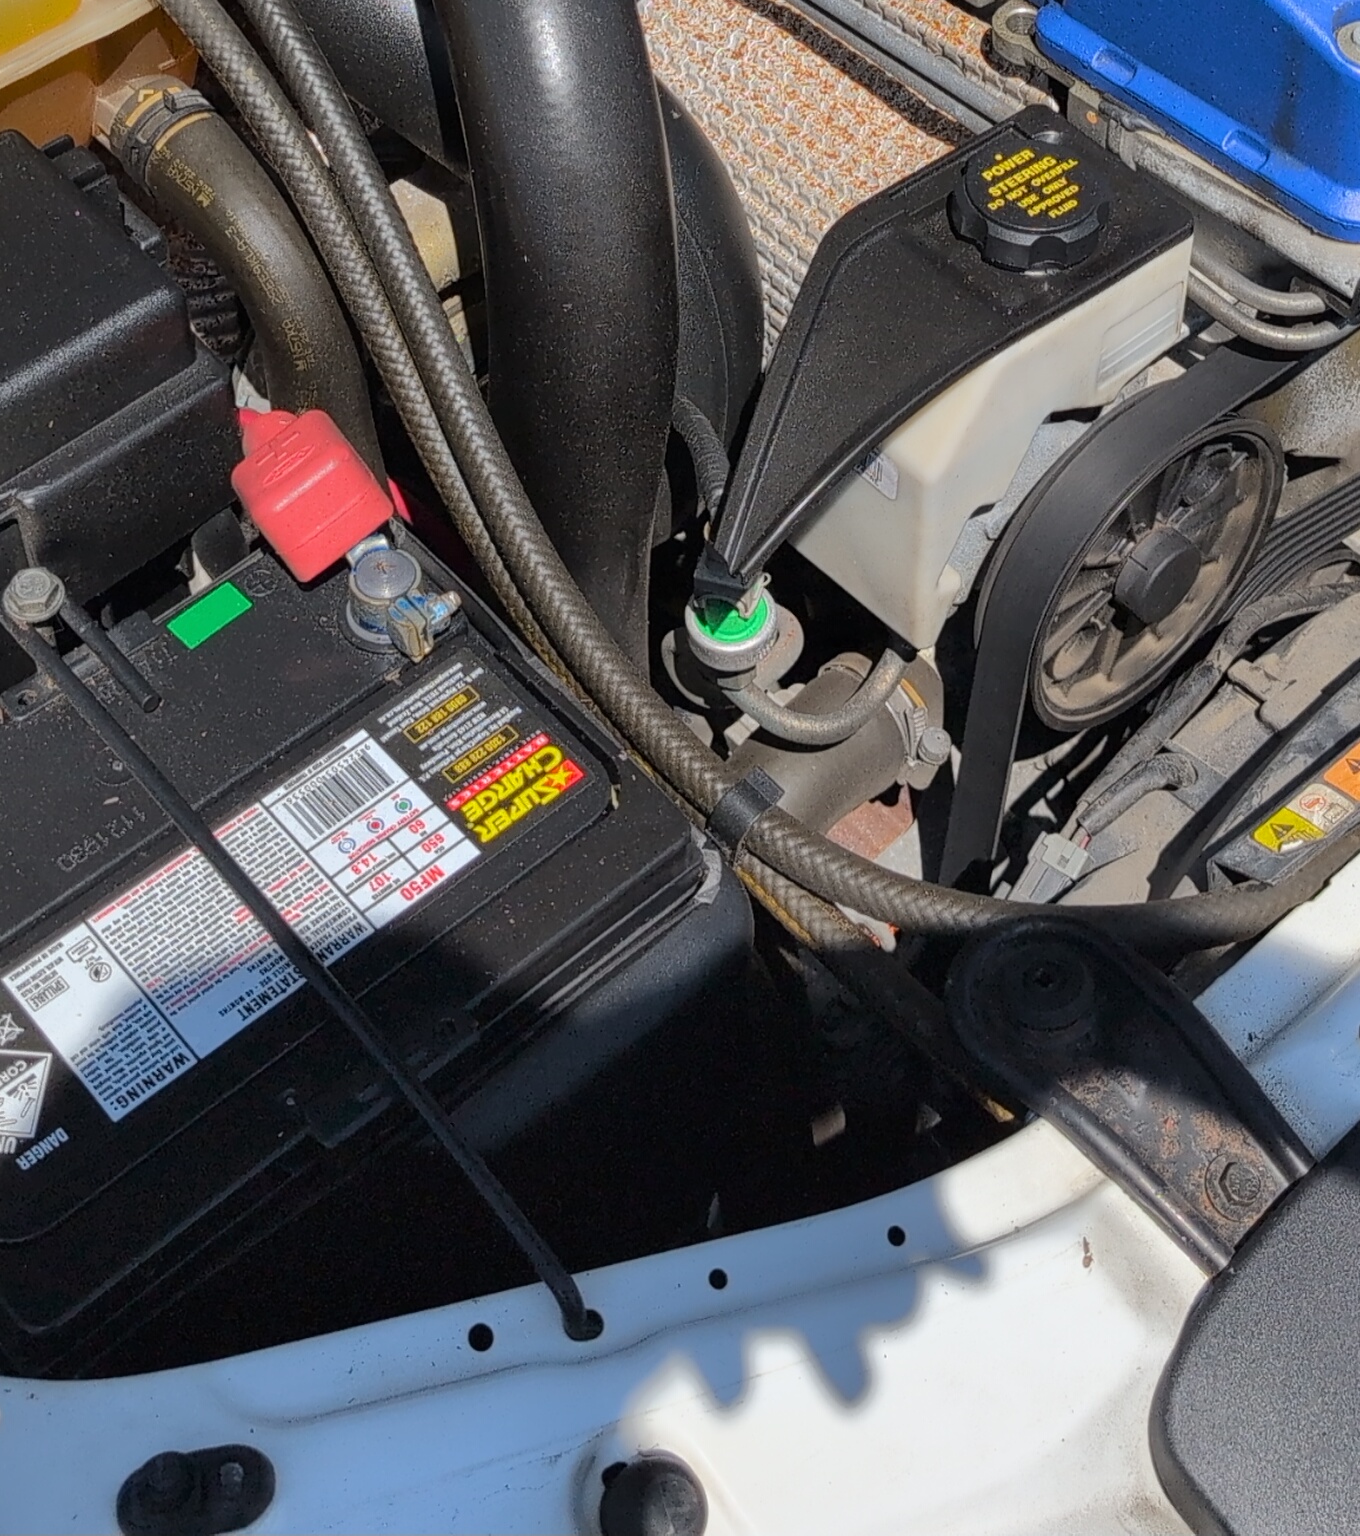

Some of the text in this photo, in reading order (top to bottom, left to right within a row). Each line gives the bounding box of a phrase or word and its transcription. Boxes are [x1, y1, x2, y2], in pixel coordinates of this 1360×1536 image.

[980, 147, 1036, 181] POWER
[987, 154, 1059, 198] STEERING
[987, 157, 1080, 212] DO NOT OVERFILL
[1016, 175, 1069, 209] USE ONLY
[1026, 184, 1081, 218] APPROVED
[1047, 198, 1079, 220] FLUID
[412, 716, 434, 734] 122
[447, 734, 548, 808] BATTERIES
[456, 740, 569, 827] CHARGE
[406, 817, 427, 835] 60
[469, 774, 562, 848] SUPER
[419, 831, 446, 854] 650
[348, 850, 380, 876] 14.8
[365, 869, 393, 892] 107
[397, 863, 446, 903] MF50
[39, 951, 49, 960] IN
[46, 940, 64, 955] MADE
[233, 919, 368, 1023] WARRAN STATEMENT
[28, 978, 66, 1008] SPILLABLE
[108, 1049, 191, 1114] WARNING:
[13, 1125, 70, 1172] DANGER
